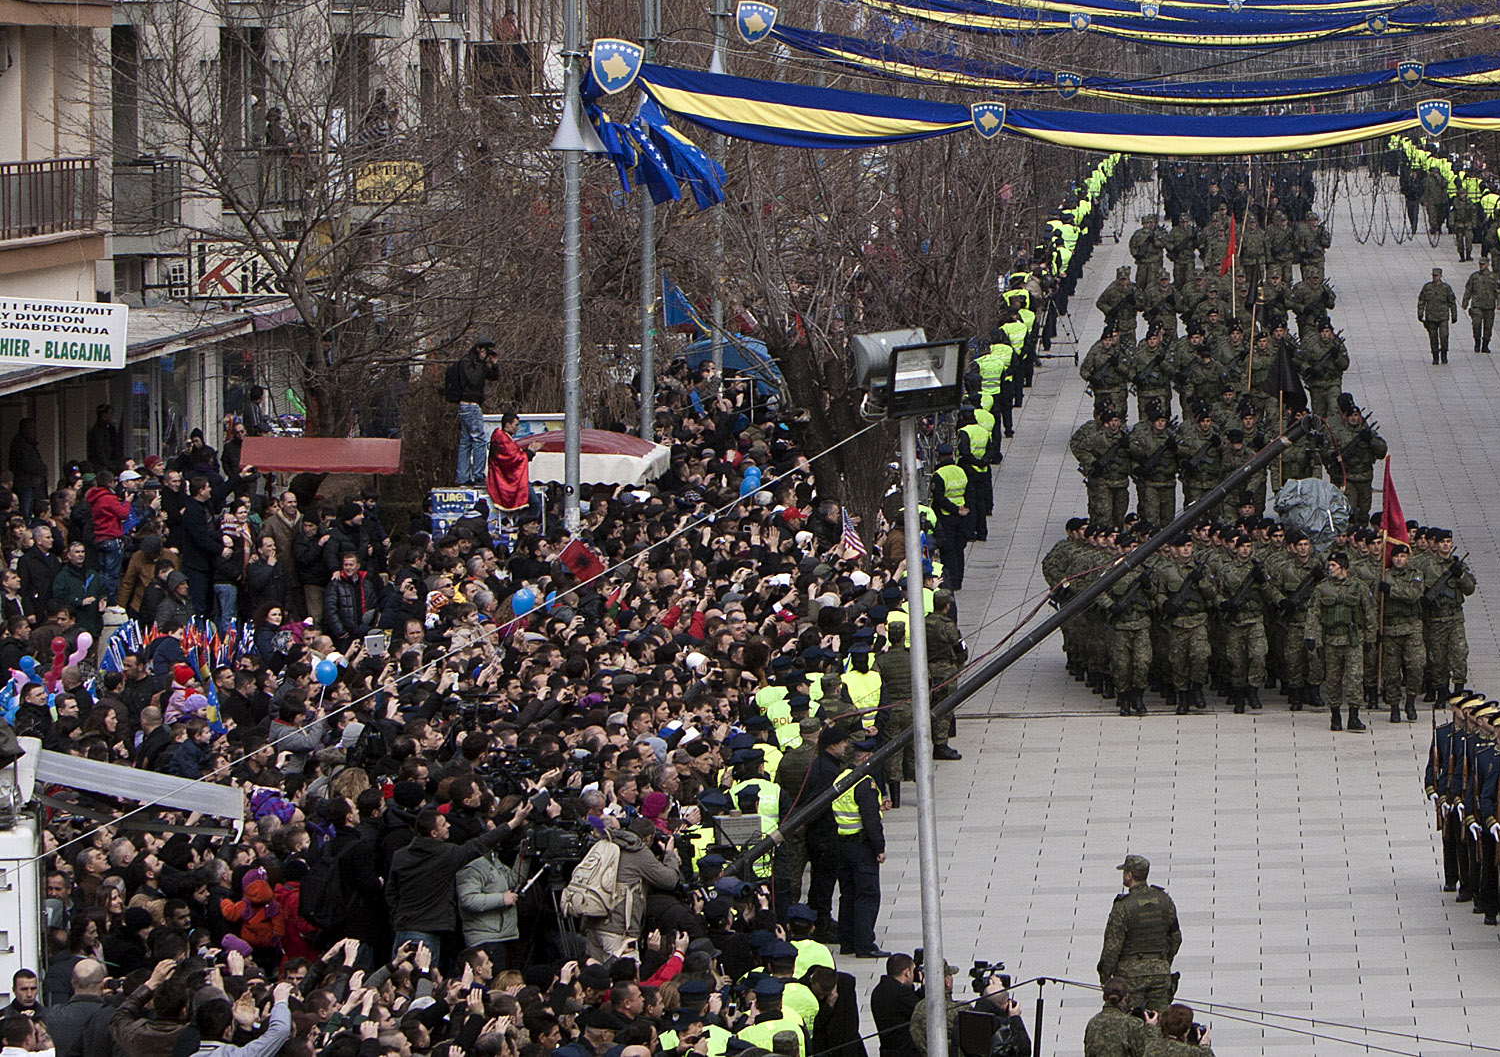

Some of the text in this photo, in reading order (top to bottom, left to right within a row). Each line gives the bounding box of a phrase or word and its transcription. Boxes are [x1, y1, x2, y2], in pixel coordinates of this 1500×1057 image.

[23, 303, 114, 316] FURNIZIMIT
[15, 313, 85, 324] DIVISION
[1, 321, 110, 335] SNABDEVANJA
[44, 340, 112, 362] BLAGAJNA
